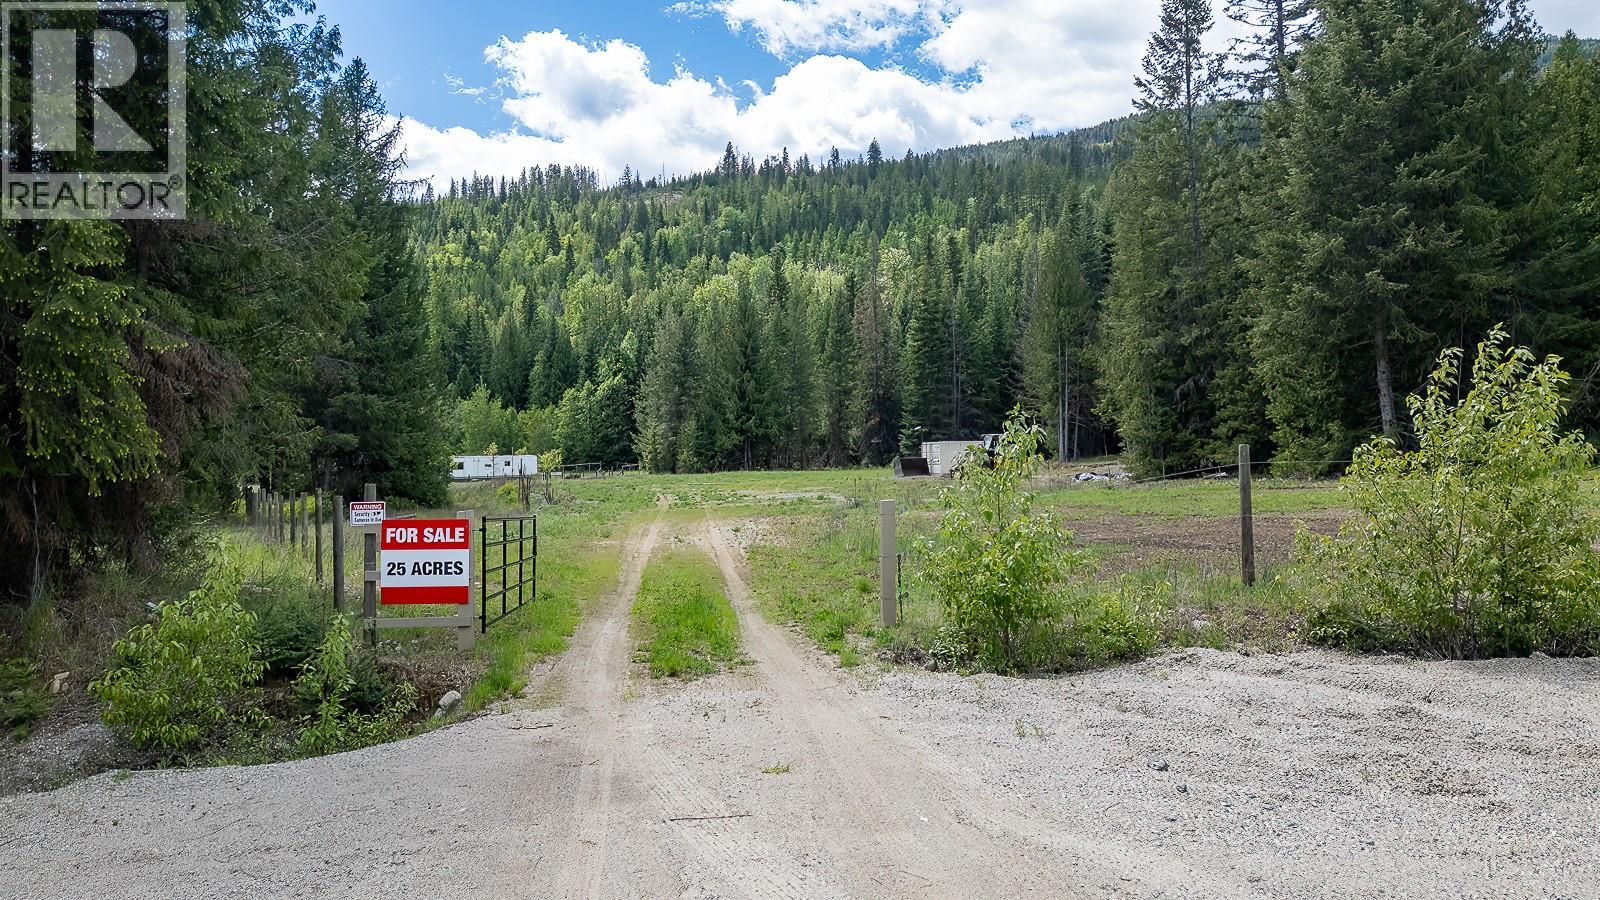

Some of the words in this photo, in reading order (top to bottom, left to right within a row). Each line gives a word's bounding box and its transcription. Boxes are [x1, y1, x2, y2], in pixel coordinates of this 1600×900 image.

[386, 528, 418, 543] FOR
[423, 527, 465, 542] SALE
[386, 562, 406, 576] 25
[411, 561, 464, 576] ACRES
